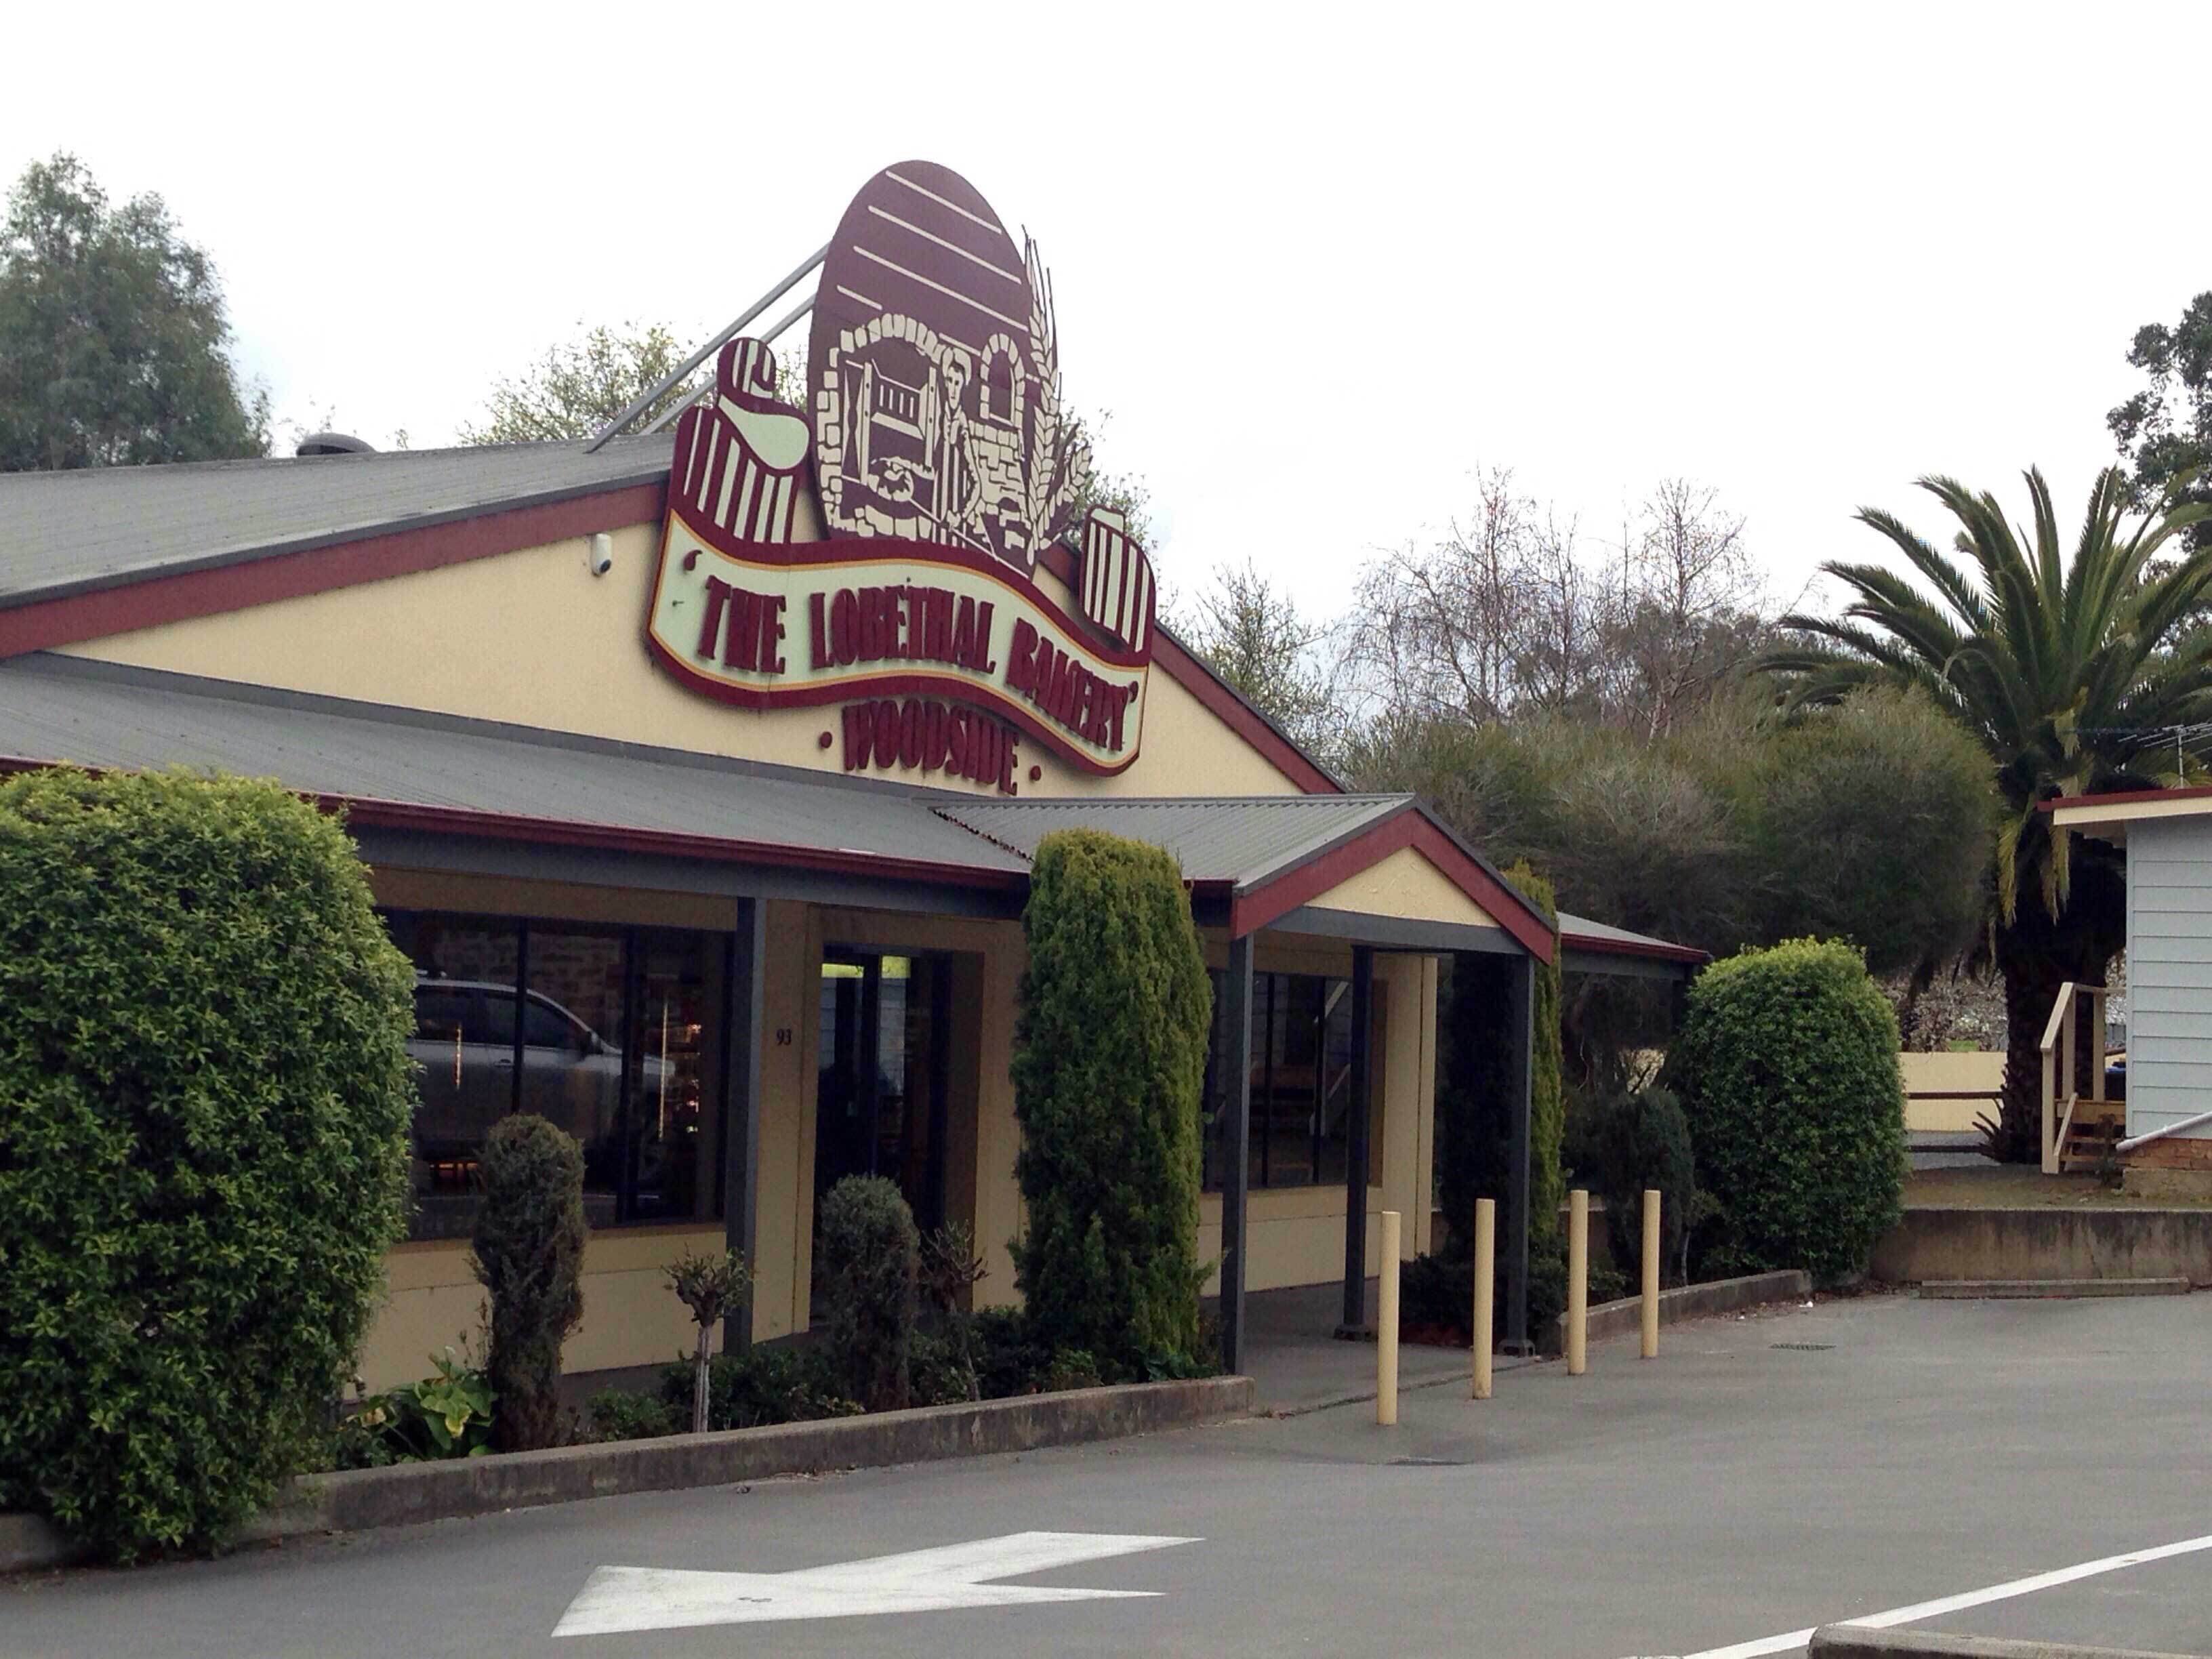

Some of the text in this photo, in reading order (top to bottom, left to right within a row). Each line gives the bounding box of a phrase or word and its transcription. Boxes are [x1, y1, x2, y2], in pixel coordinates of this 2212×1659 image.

[809, 585, 996, 674] LOBETHAL
[842, 699, 1021, 796] WOODSIDE
[777, 1029, 792, 1046] 93
